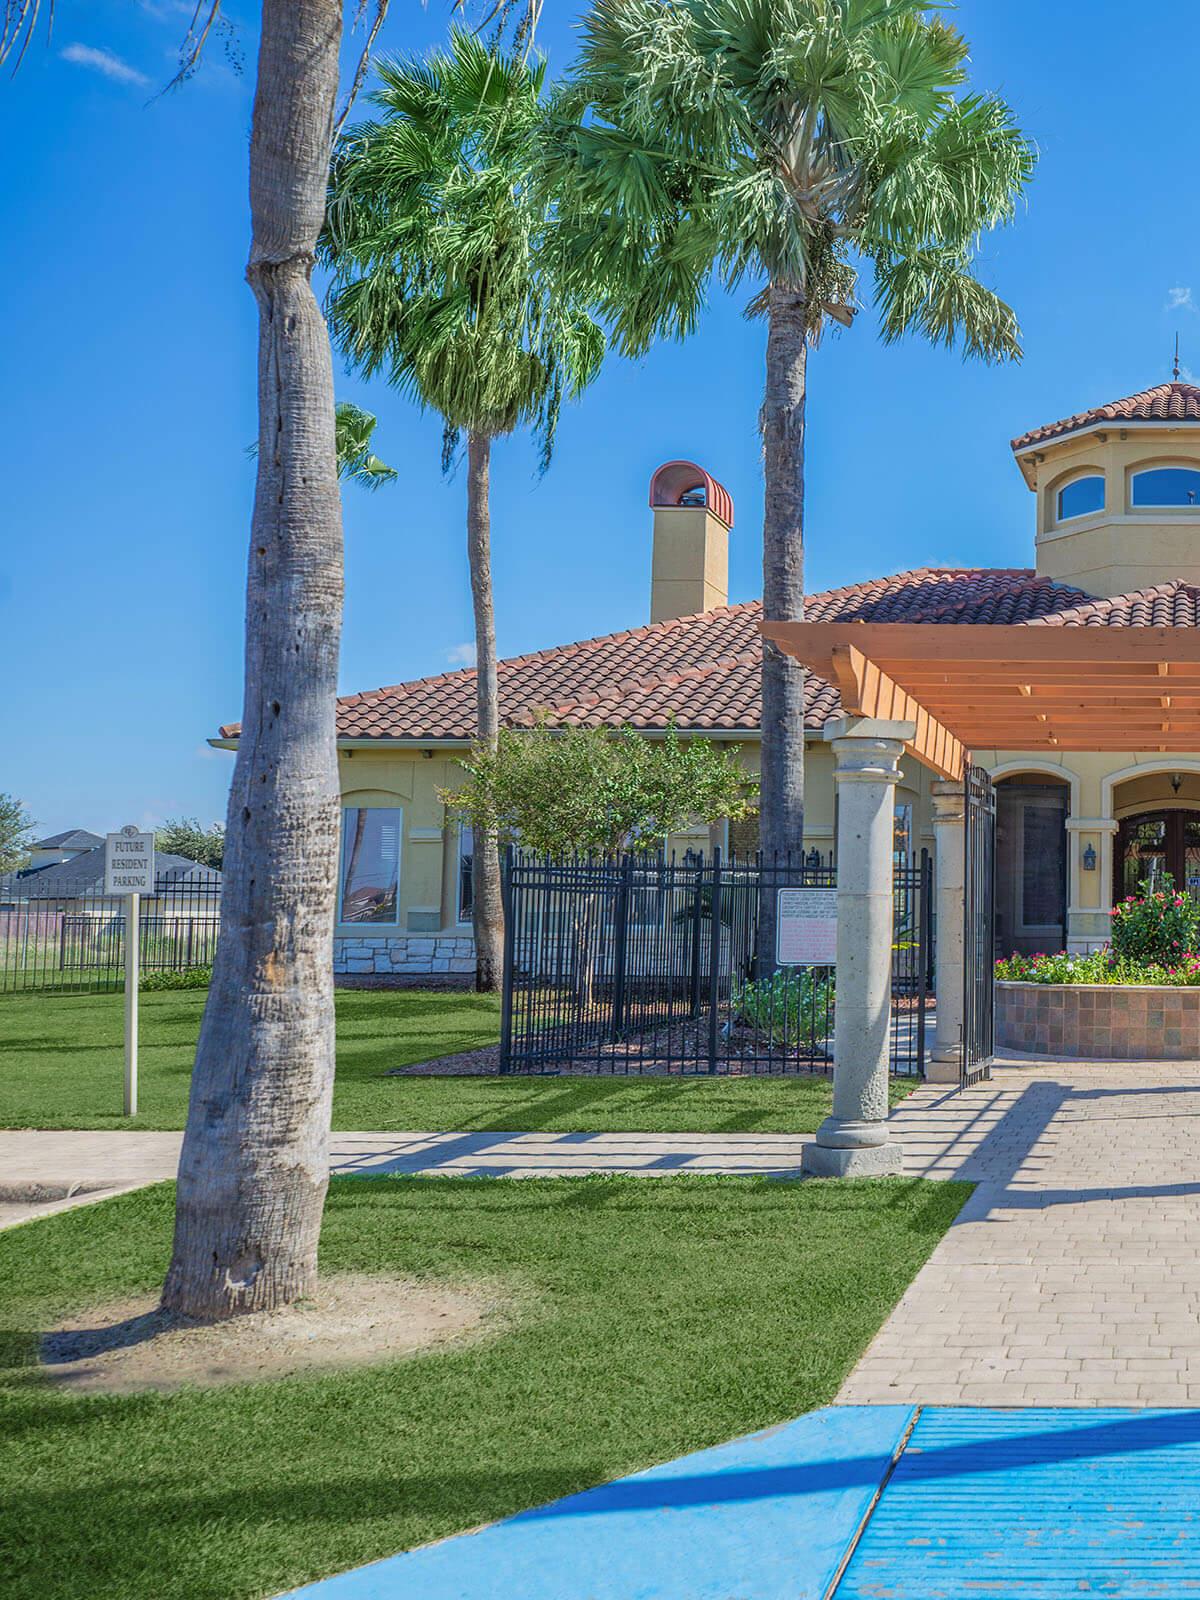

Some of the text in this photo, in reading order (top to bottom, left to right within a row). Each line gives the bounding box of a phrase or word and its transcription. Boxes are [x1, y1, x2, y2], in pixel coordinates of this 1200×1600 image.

[115, 841, 144, 852] FUTURE
[112, 859, 148, 869] RESIDENT
[113, 876, 146, 886] PARKING
